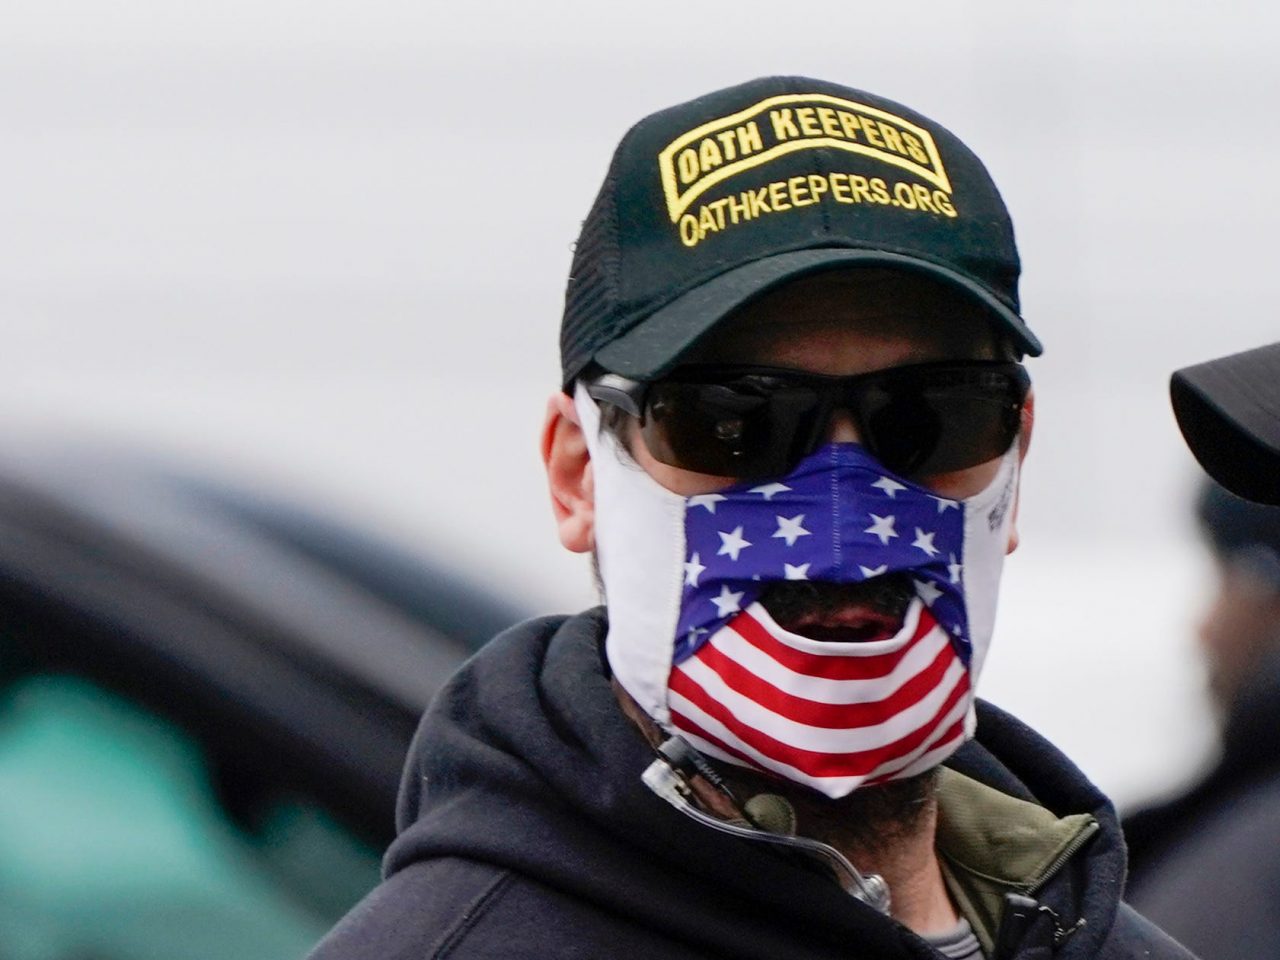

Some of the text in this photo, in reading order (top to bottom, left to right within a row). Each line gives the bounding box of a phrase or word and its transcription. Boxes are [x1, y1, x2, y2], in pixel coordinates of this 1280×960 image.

[677, 107, 930, 184] OATH KEEPERS
[679, 172, 959, 248] OATHKEEPERS.ORG
